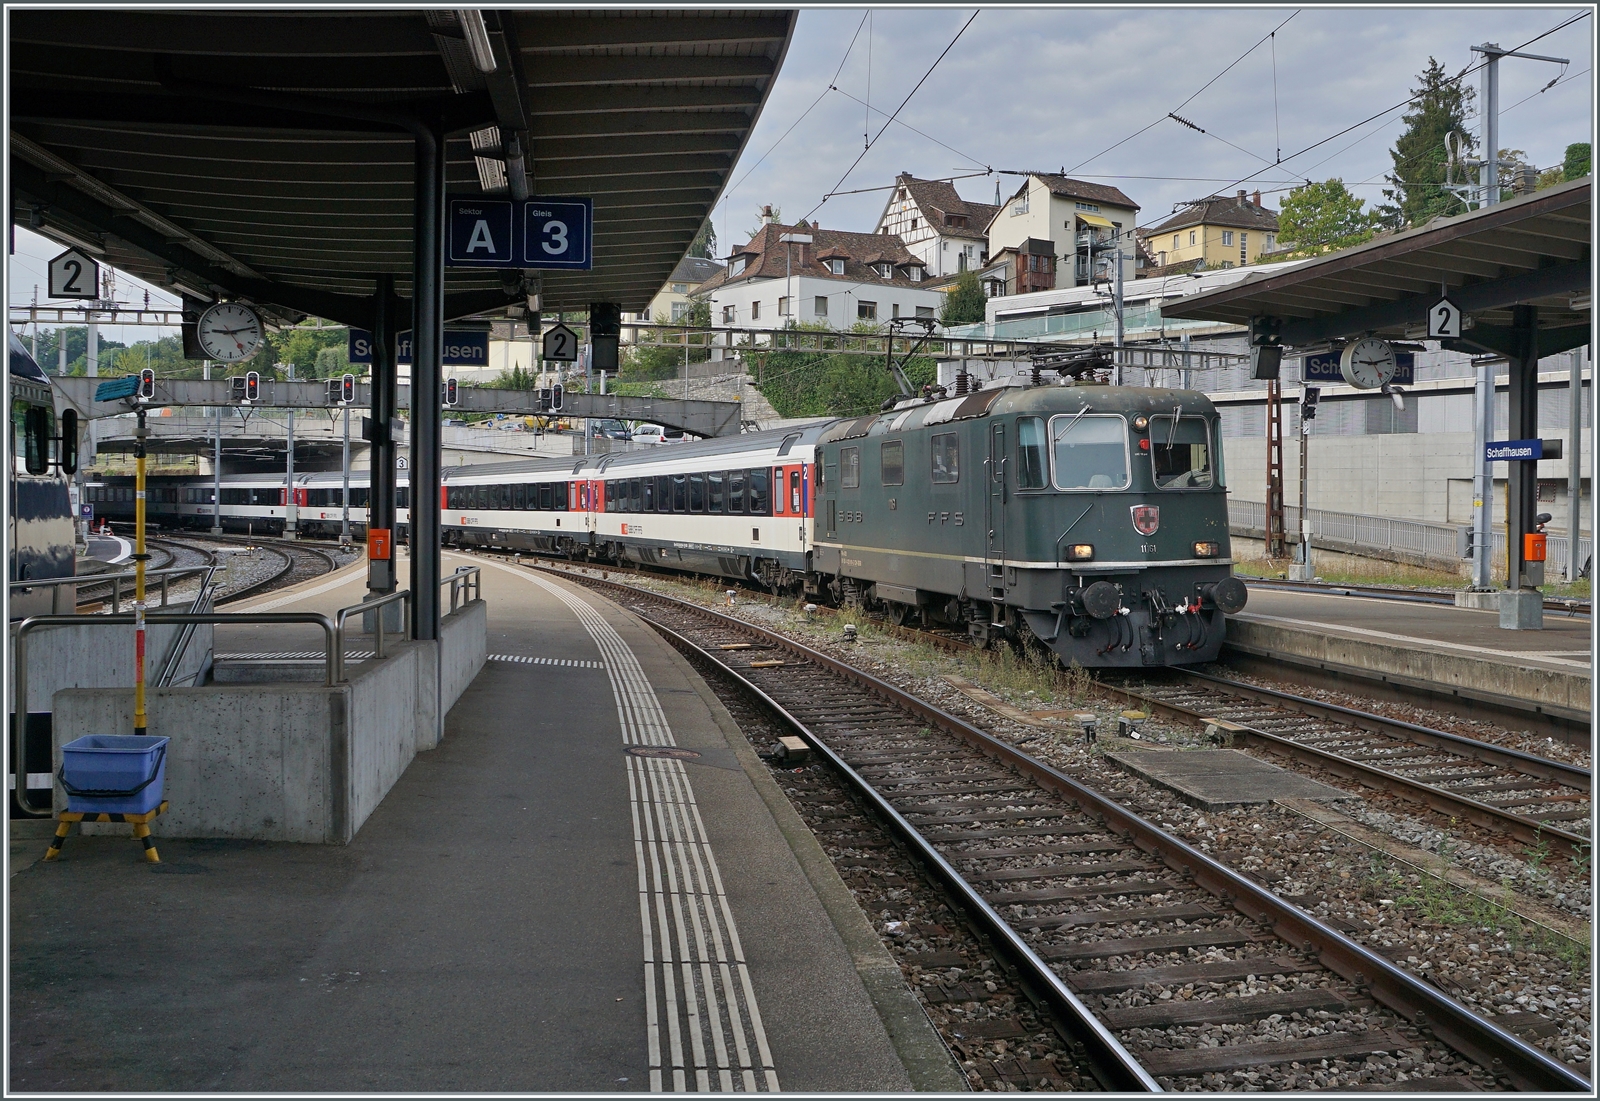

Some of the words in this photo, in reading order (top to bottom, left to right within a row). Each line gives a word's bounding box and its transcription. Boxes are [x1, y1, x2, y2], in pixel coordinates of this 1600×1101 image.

[459, 207, 483, 215] Sektor
[532, 209, 552, 217] Gleis
[466, 219, 496, 253] A
[541, 220, 569, 255] 3
[63, 260, 82, 292] 2
[1438, 307, 1451, 334] 2
[553, 333, 567, 356] 2
[1487, 447, 1532, 458] Schaffhausen
[399, 460, 405, 468] 3
[803, 466, 808, 479] 2
[839, 510, 863, 522] SBB
[928, 511, 964, 526] FFS
